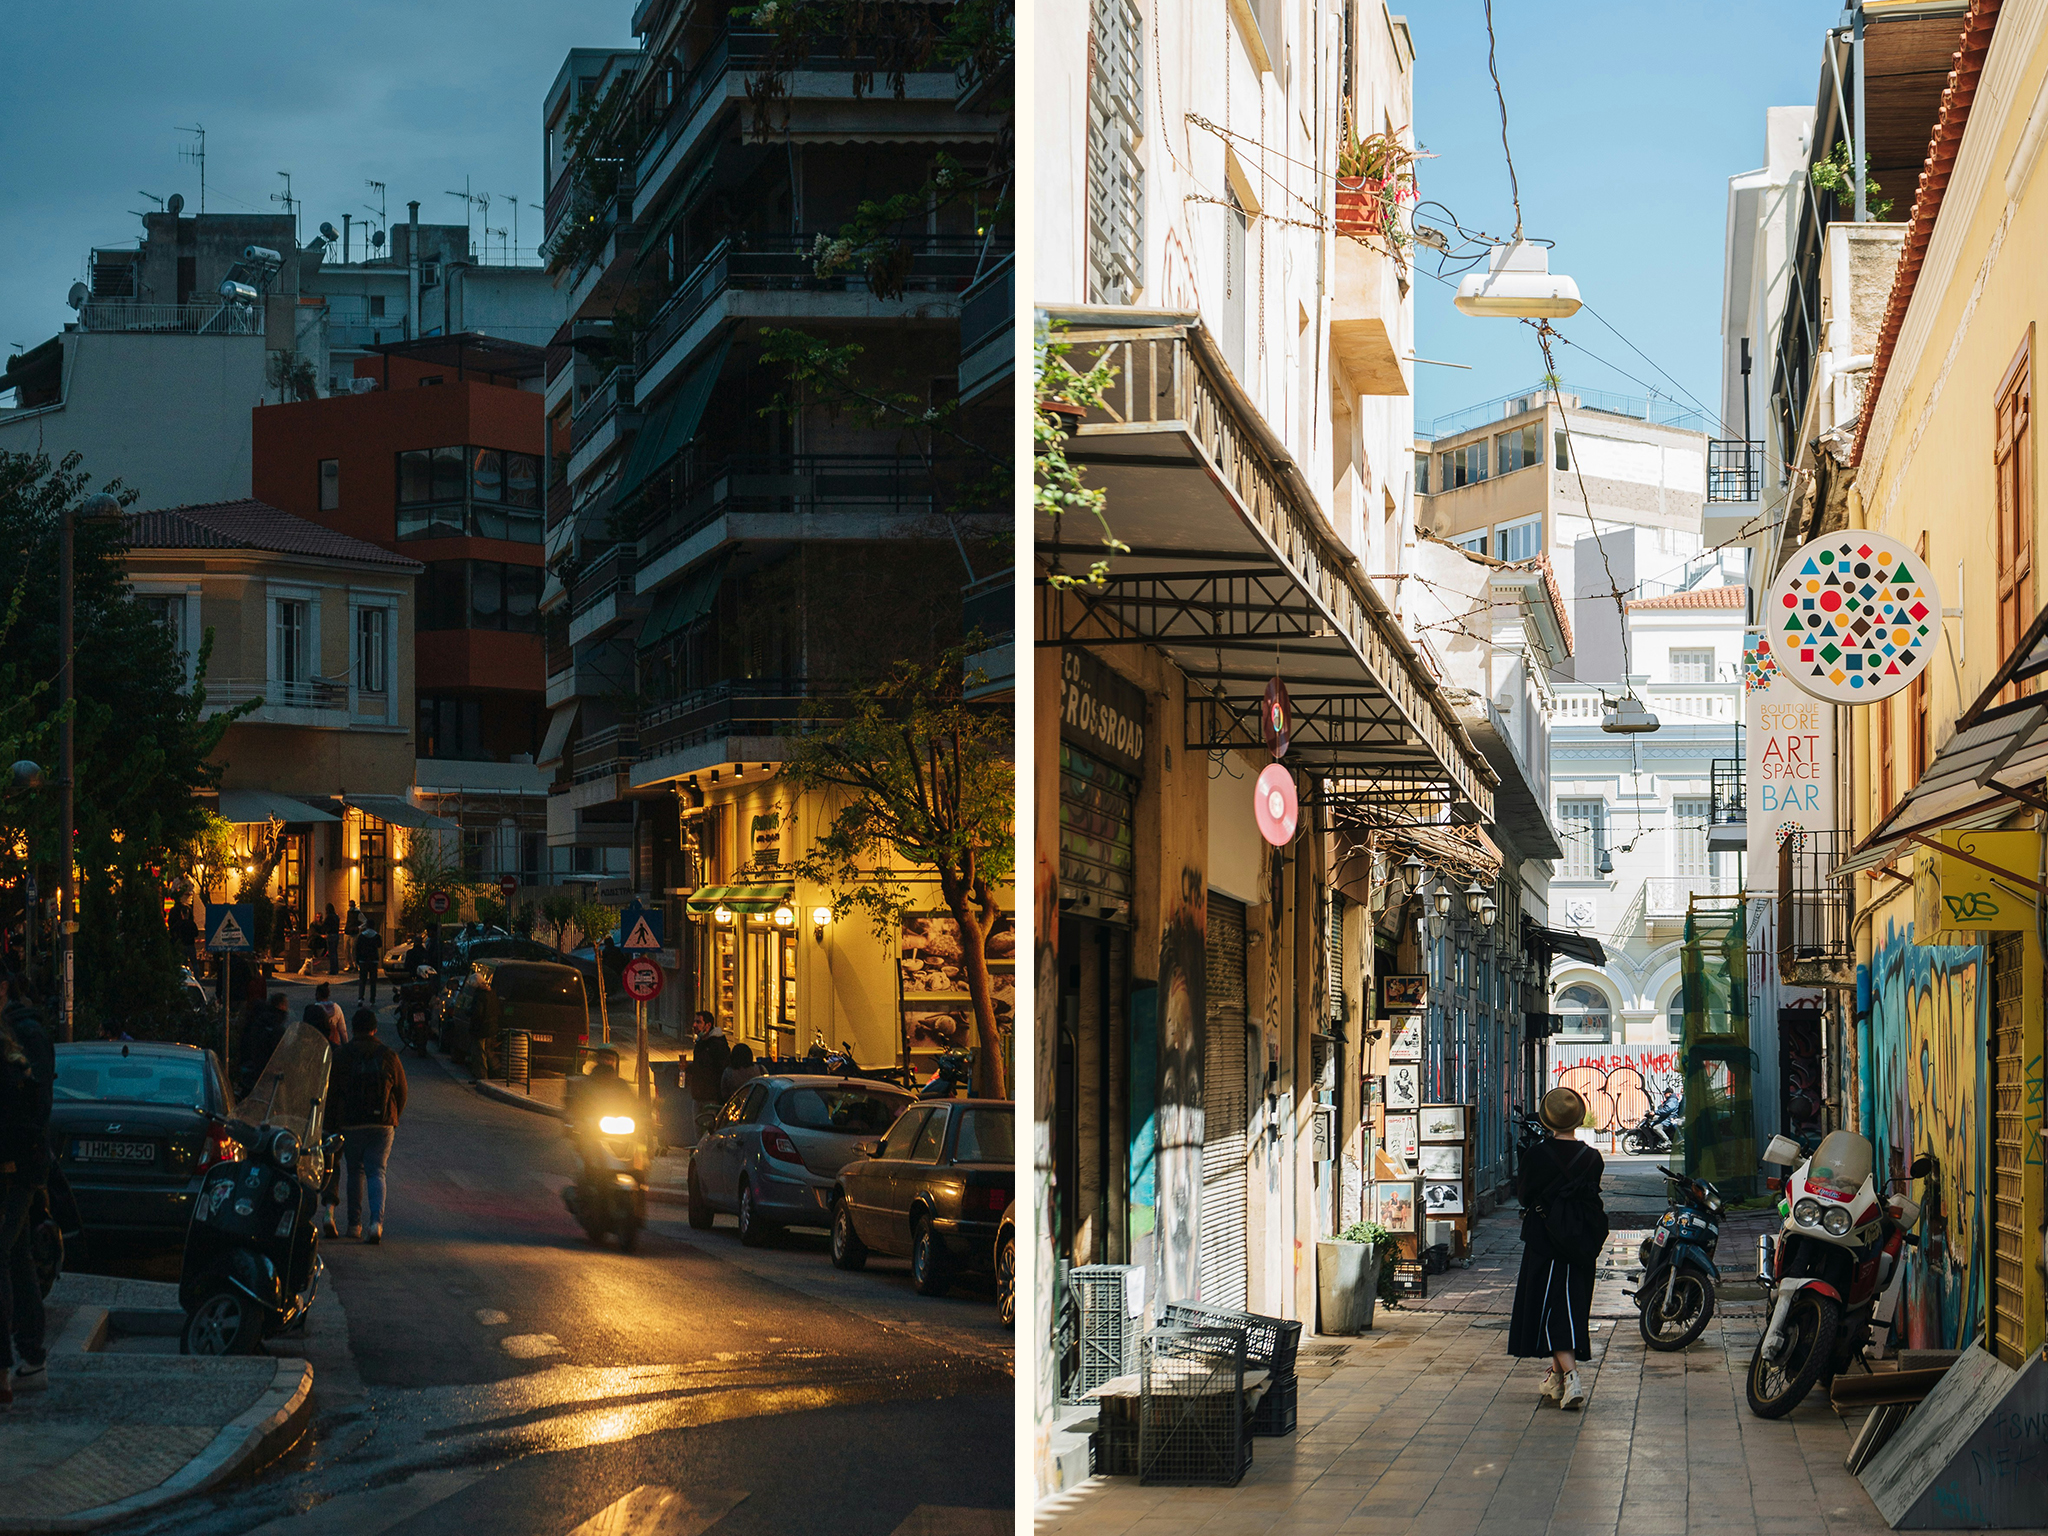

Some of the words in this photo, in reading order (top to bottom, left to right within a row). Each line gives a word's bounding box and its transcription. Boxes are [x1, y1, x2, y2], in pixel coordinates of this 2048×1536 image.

[1761, 703, 1819, 714] BOUTIQUE
[1761, 714, 1820, 731] STORE
[1762, 735, 1820, 763] ART
[1762, 763, 1820, 780] SPACE
[1762, 784, 1820, 811] BAR
[1943, 892, 2000, 919] DOS
